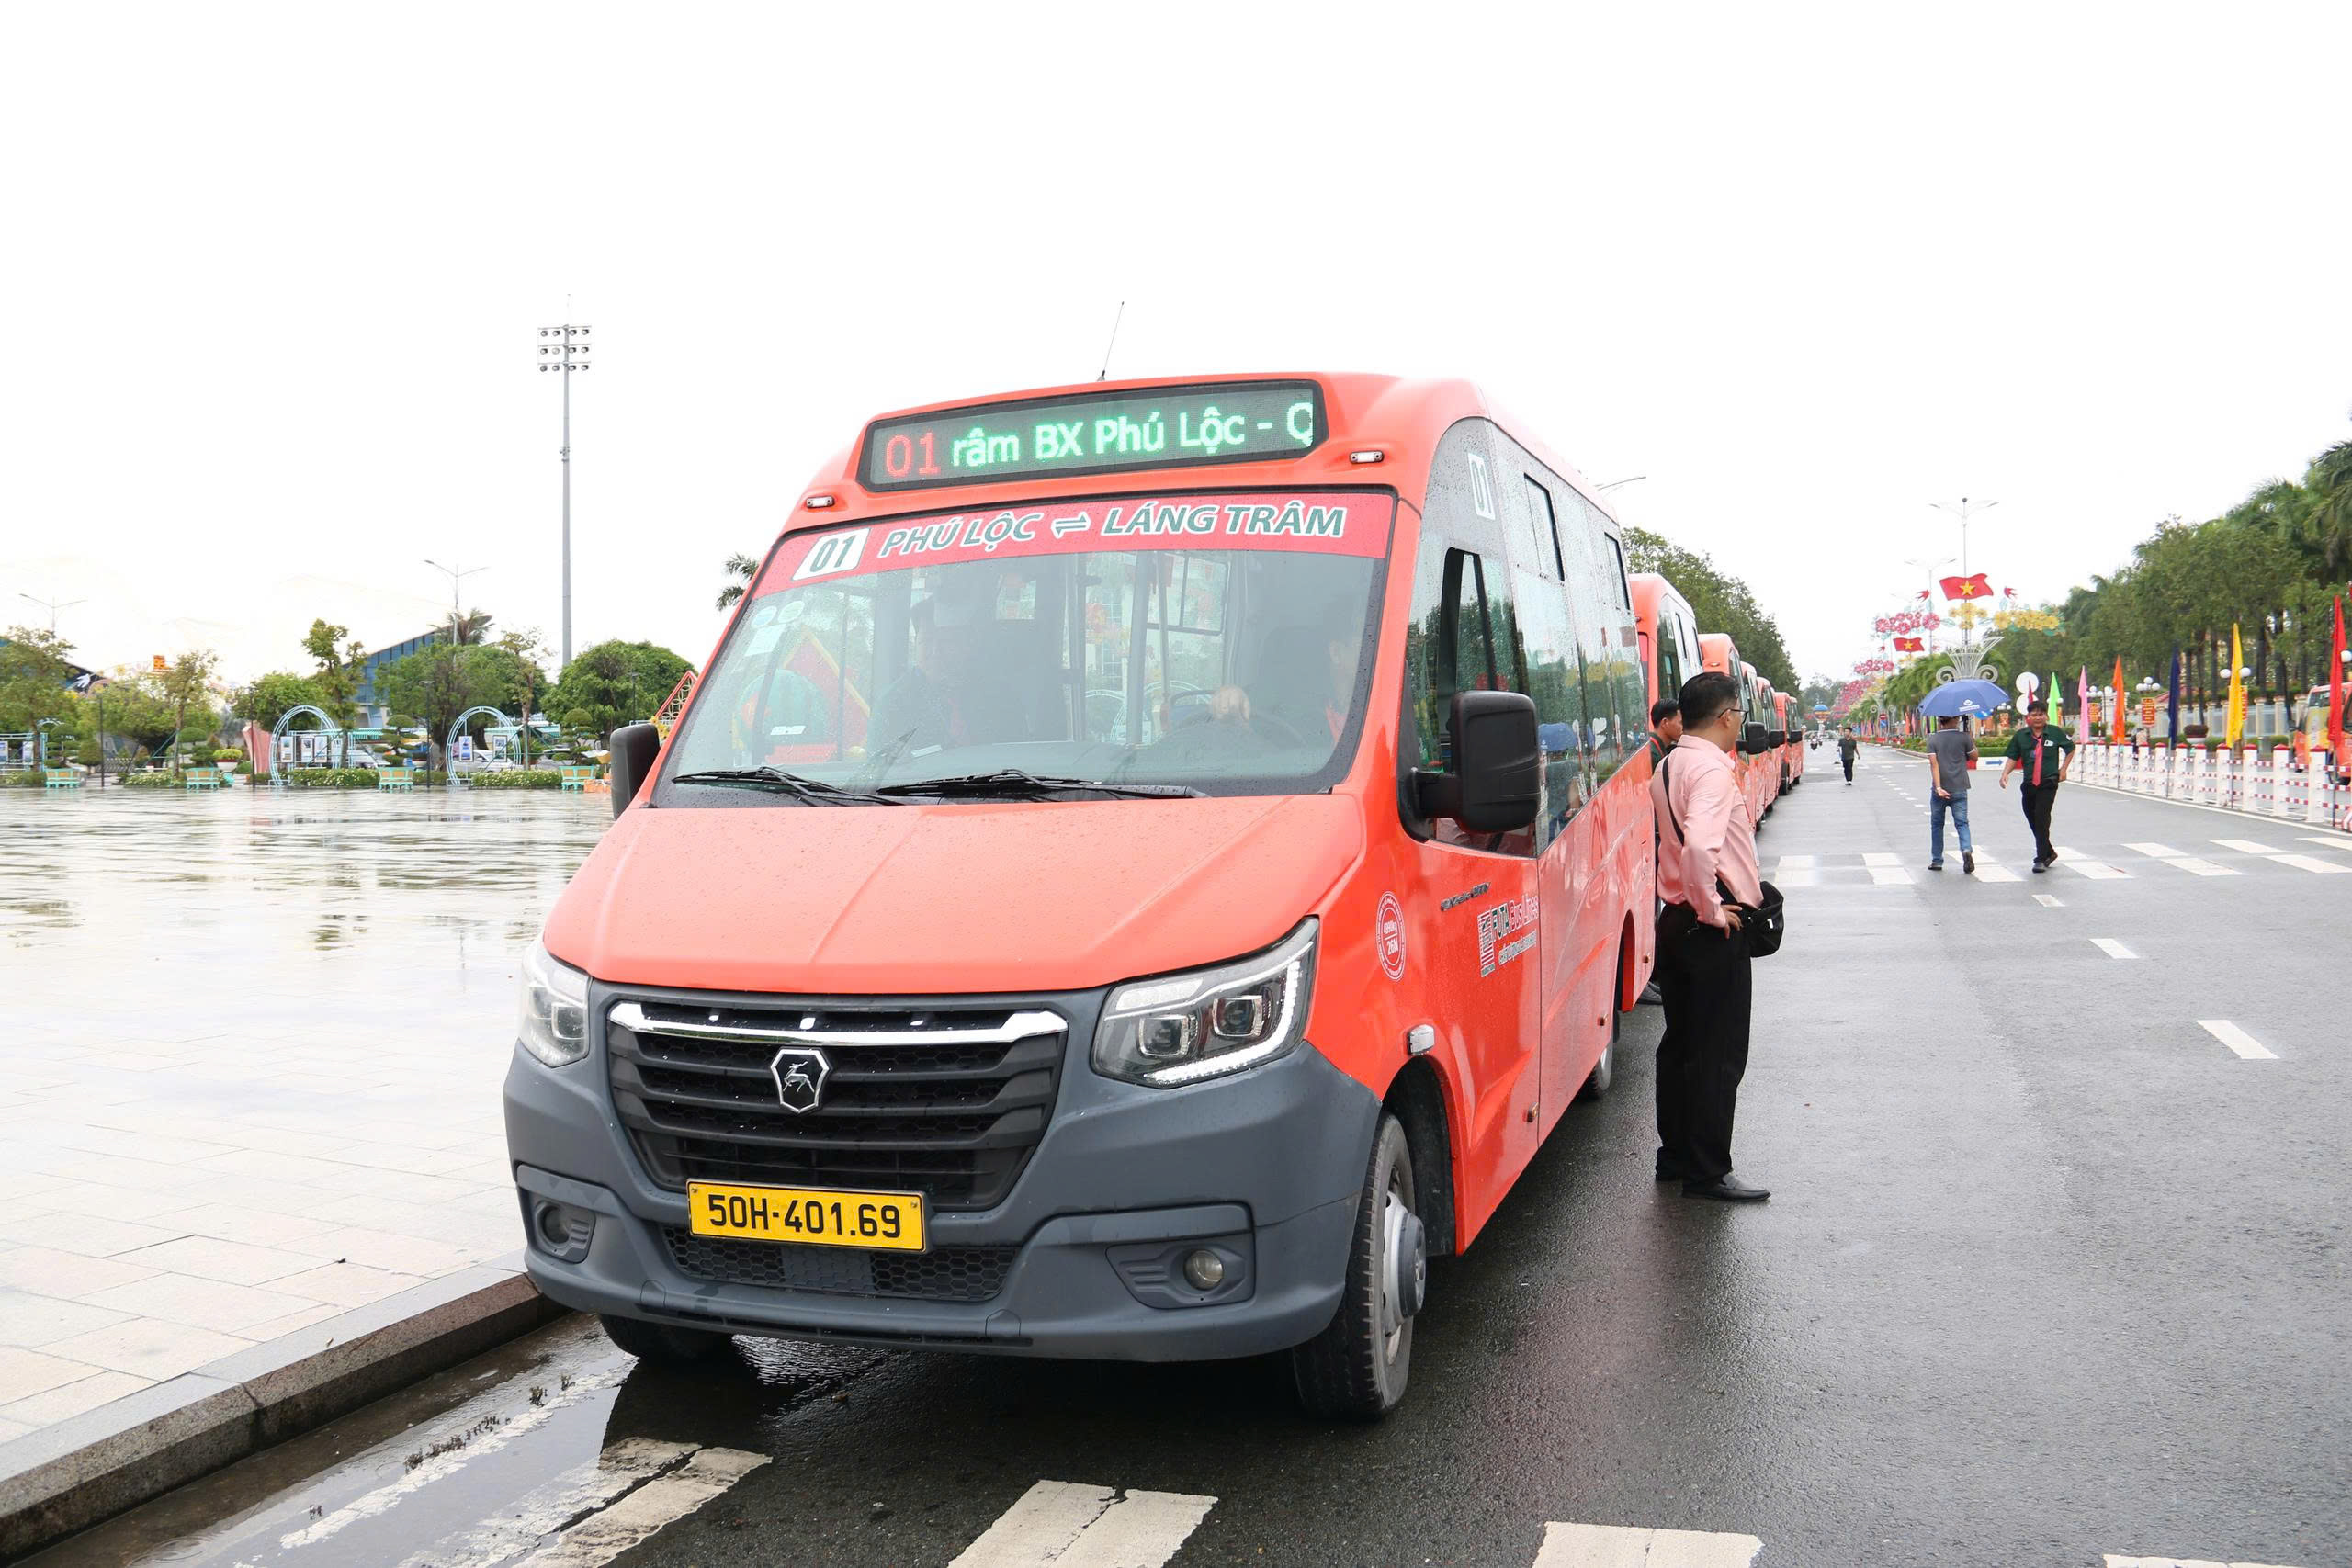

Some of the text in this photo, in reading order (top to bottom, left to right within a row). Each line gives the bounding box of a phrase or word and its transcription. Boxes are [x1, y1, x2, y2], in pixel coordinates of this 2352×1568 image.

[886, 432, 942, 479] 01
[952, 427, 1020, 467] râm
[1035, 422, 1084, 459] BX
[1095, 411, 1164, 454] Phú
[1179, 406, 1245, 454] Lộc
[809, 535, 855, 573] 01
[877, 500, 1347, 558] PHÚ LỘC LÁNG TRÂM
[708, 1193, 900, 1238] 50H-401.69
